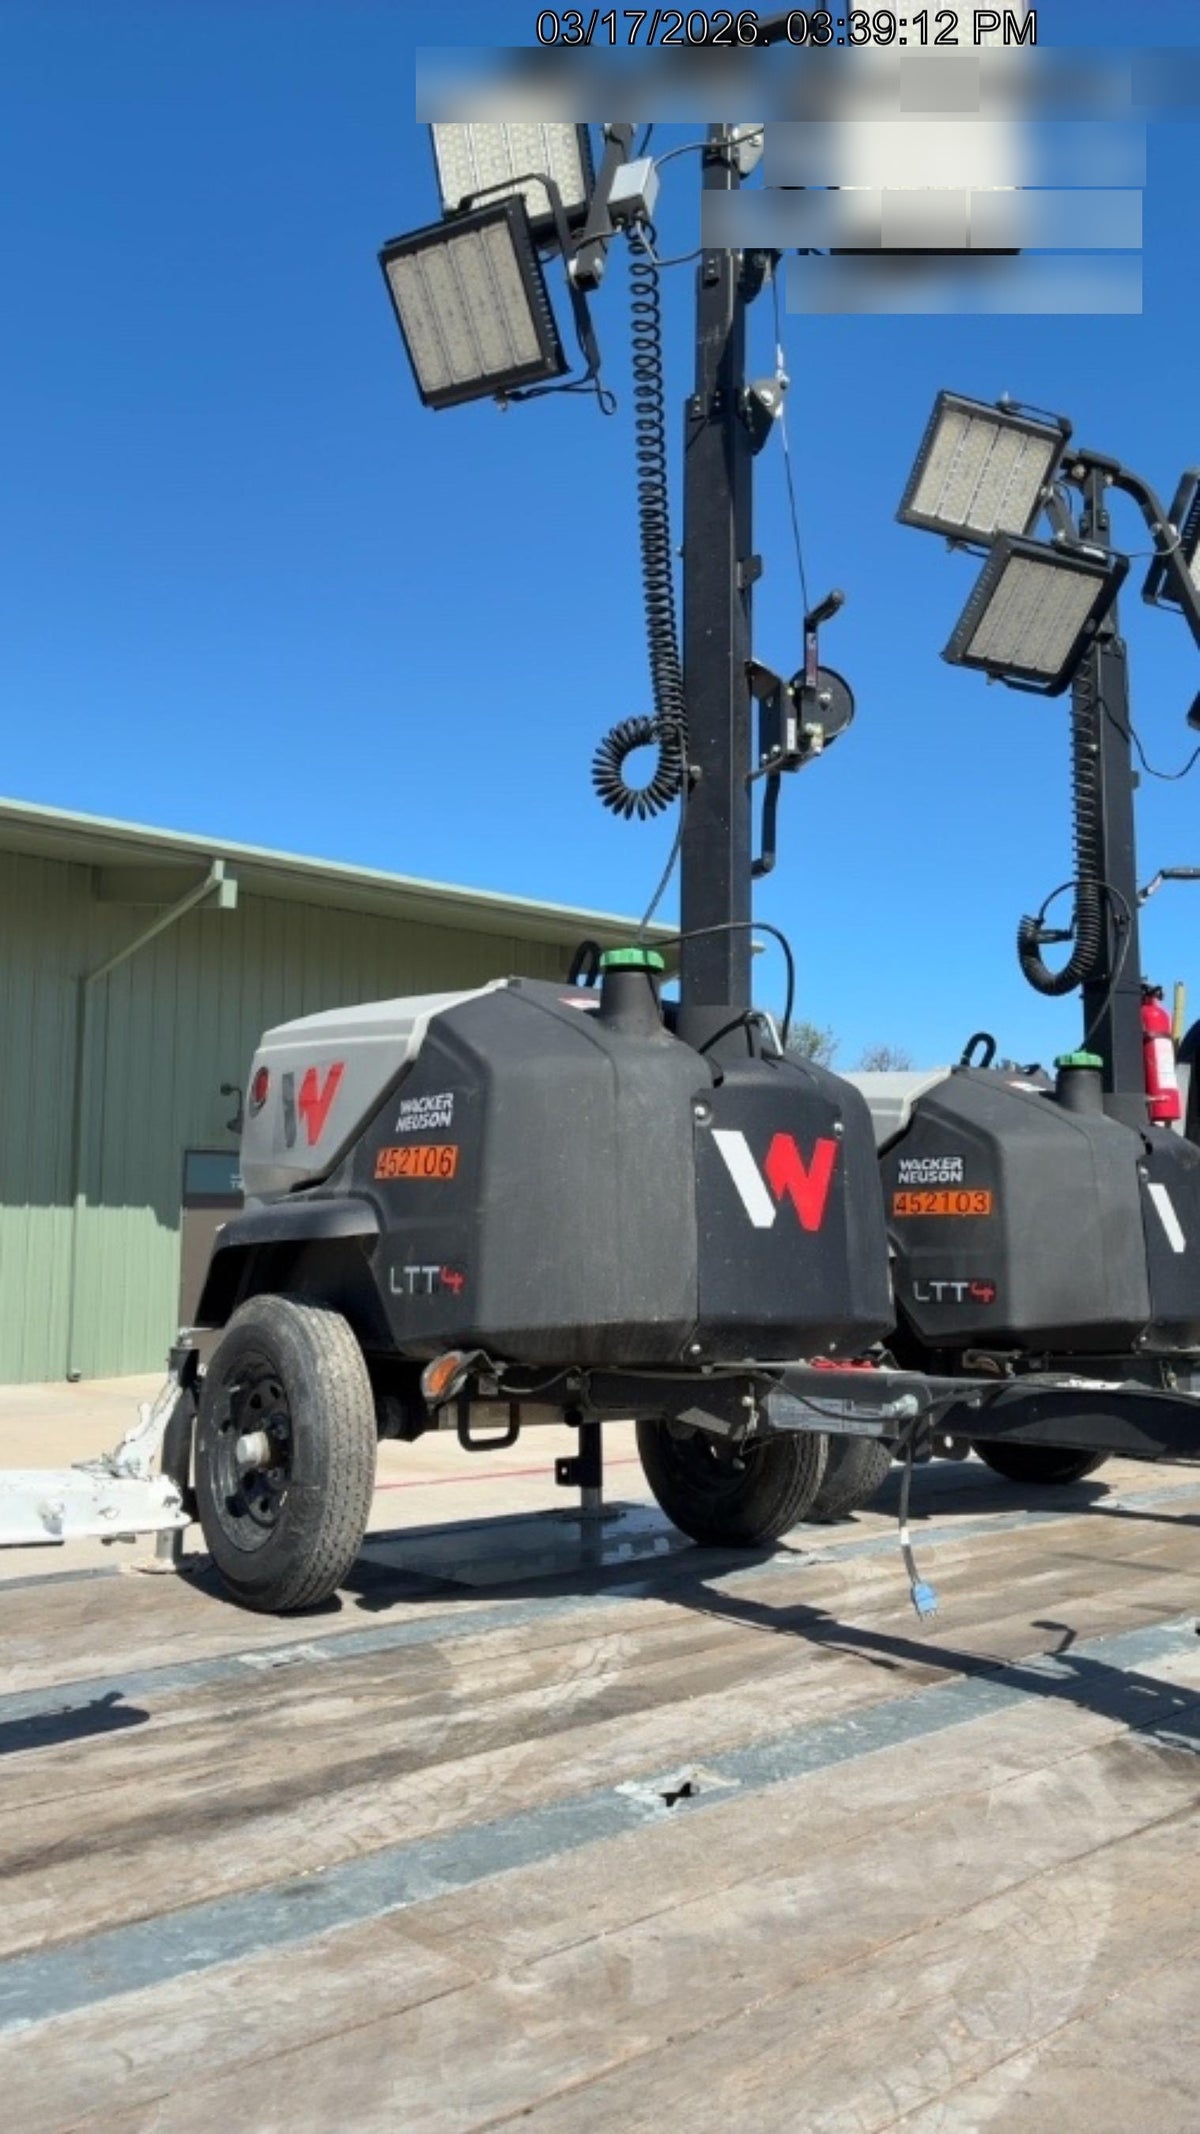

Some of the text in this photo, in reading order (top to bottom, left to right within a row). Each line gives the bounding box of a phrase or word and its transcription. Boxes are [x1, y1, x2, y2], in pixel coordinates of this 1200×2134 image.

[401, 1092, 453, 1115] WACKER
[395, 1111, 451, 1132] NEUSON
[378, 1146, 454, 1177] 452106
[900, 1157, 963, 1170] WACKER
[899, 1170, 963, 1183] NEUSON
[896, 1192, 987, 1213] 452103
[390, 1265, 463, 1294] LTT4
[913, 1281, 995, 1302] LTT4
